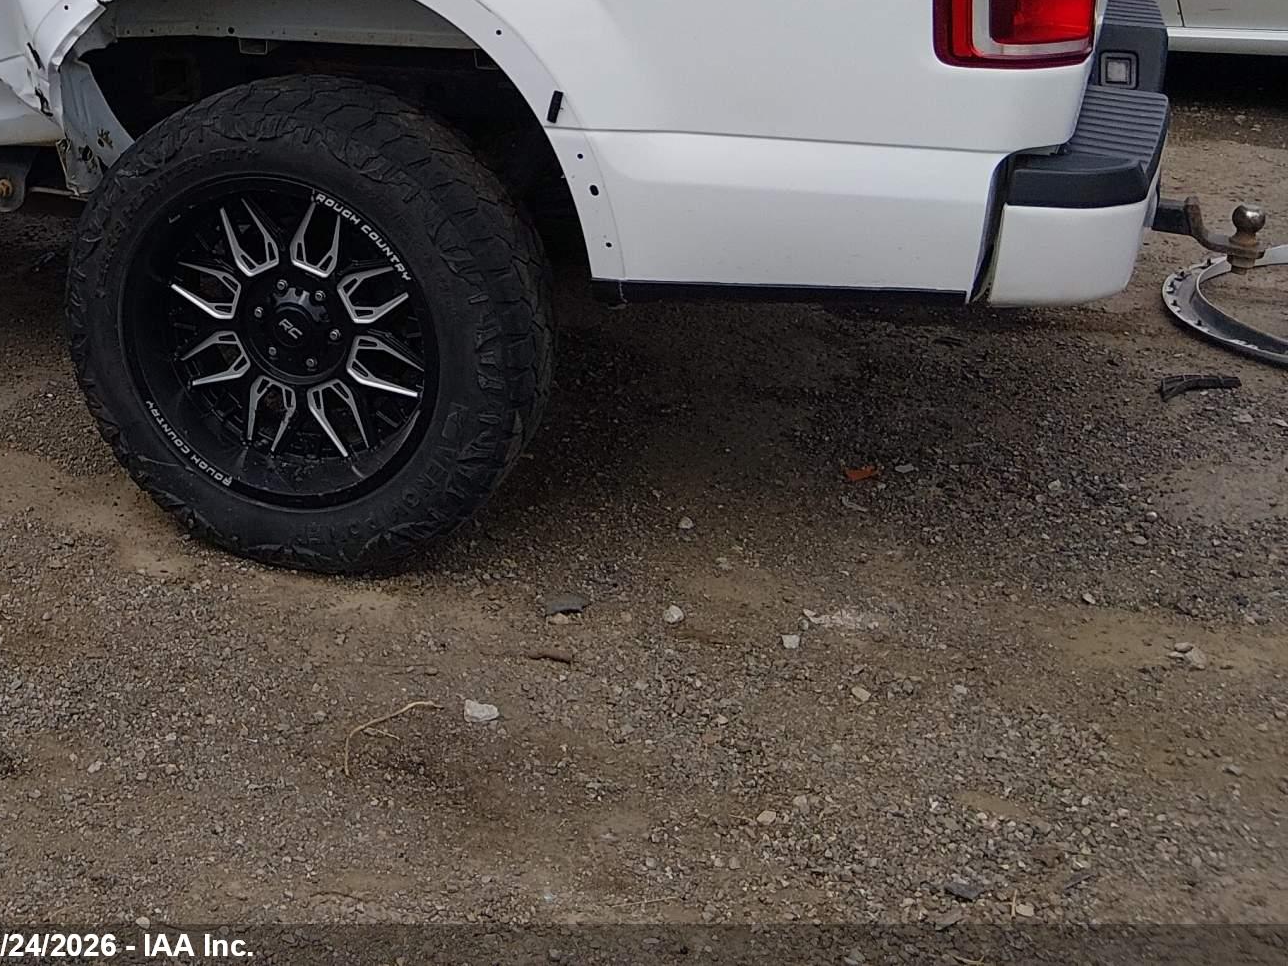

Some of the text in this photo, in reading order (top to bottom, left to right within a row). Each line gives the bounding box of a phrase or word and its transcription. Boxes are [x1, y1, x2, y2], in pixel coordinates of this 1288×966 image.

[315, 193, 411, 281] ROUGH COUNTRY
[278, 318, 303, 340] RC
[146, 400, 233, 486] ROUGH COUNTRY
